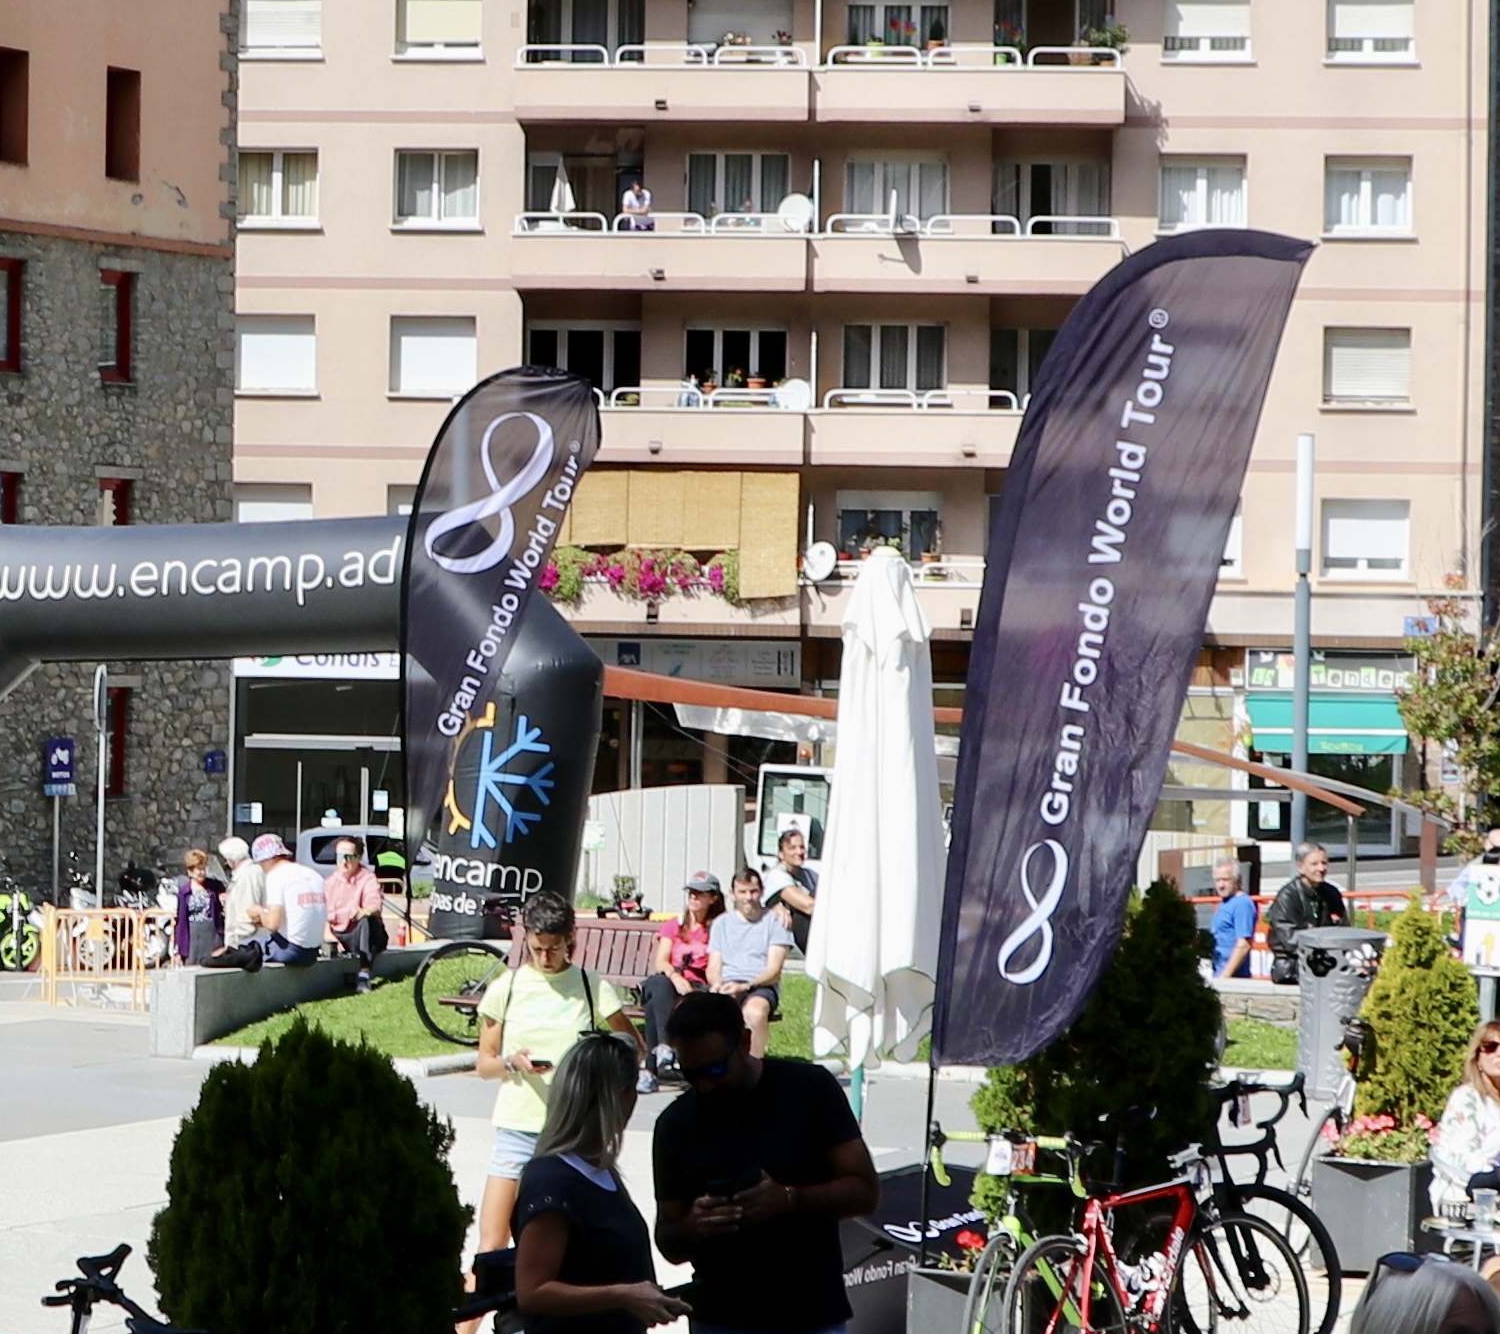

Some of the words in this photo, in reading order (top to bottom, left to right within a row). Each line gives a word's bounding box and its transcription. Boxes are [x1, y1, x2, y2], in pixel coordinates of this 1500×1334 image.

[1121, 334, 1175, 427] Tour
[1087, 441, 1147, 564] World
[437, 673, 483, 737] Gran
[466, 589, 521, 674] Fondo
[503, 514, 558, 590] World
[541, 454, 580, 512] Tour
[1059, 577, 1117, 713] Fondo
[1040, 725, 1085, 826] Gran
[453, 891, 477, 916] de
